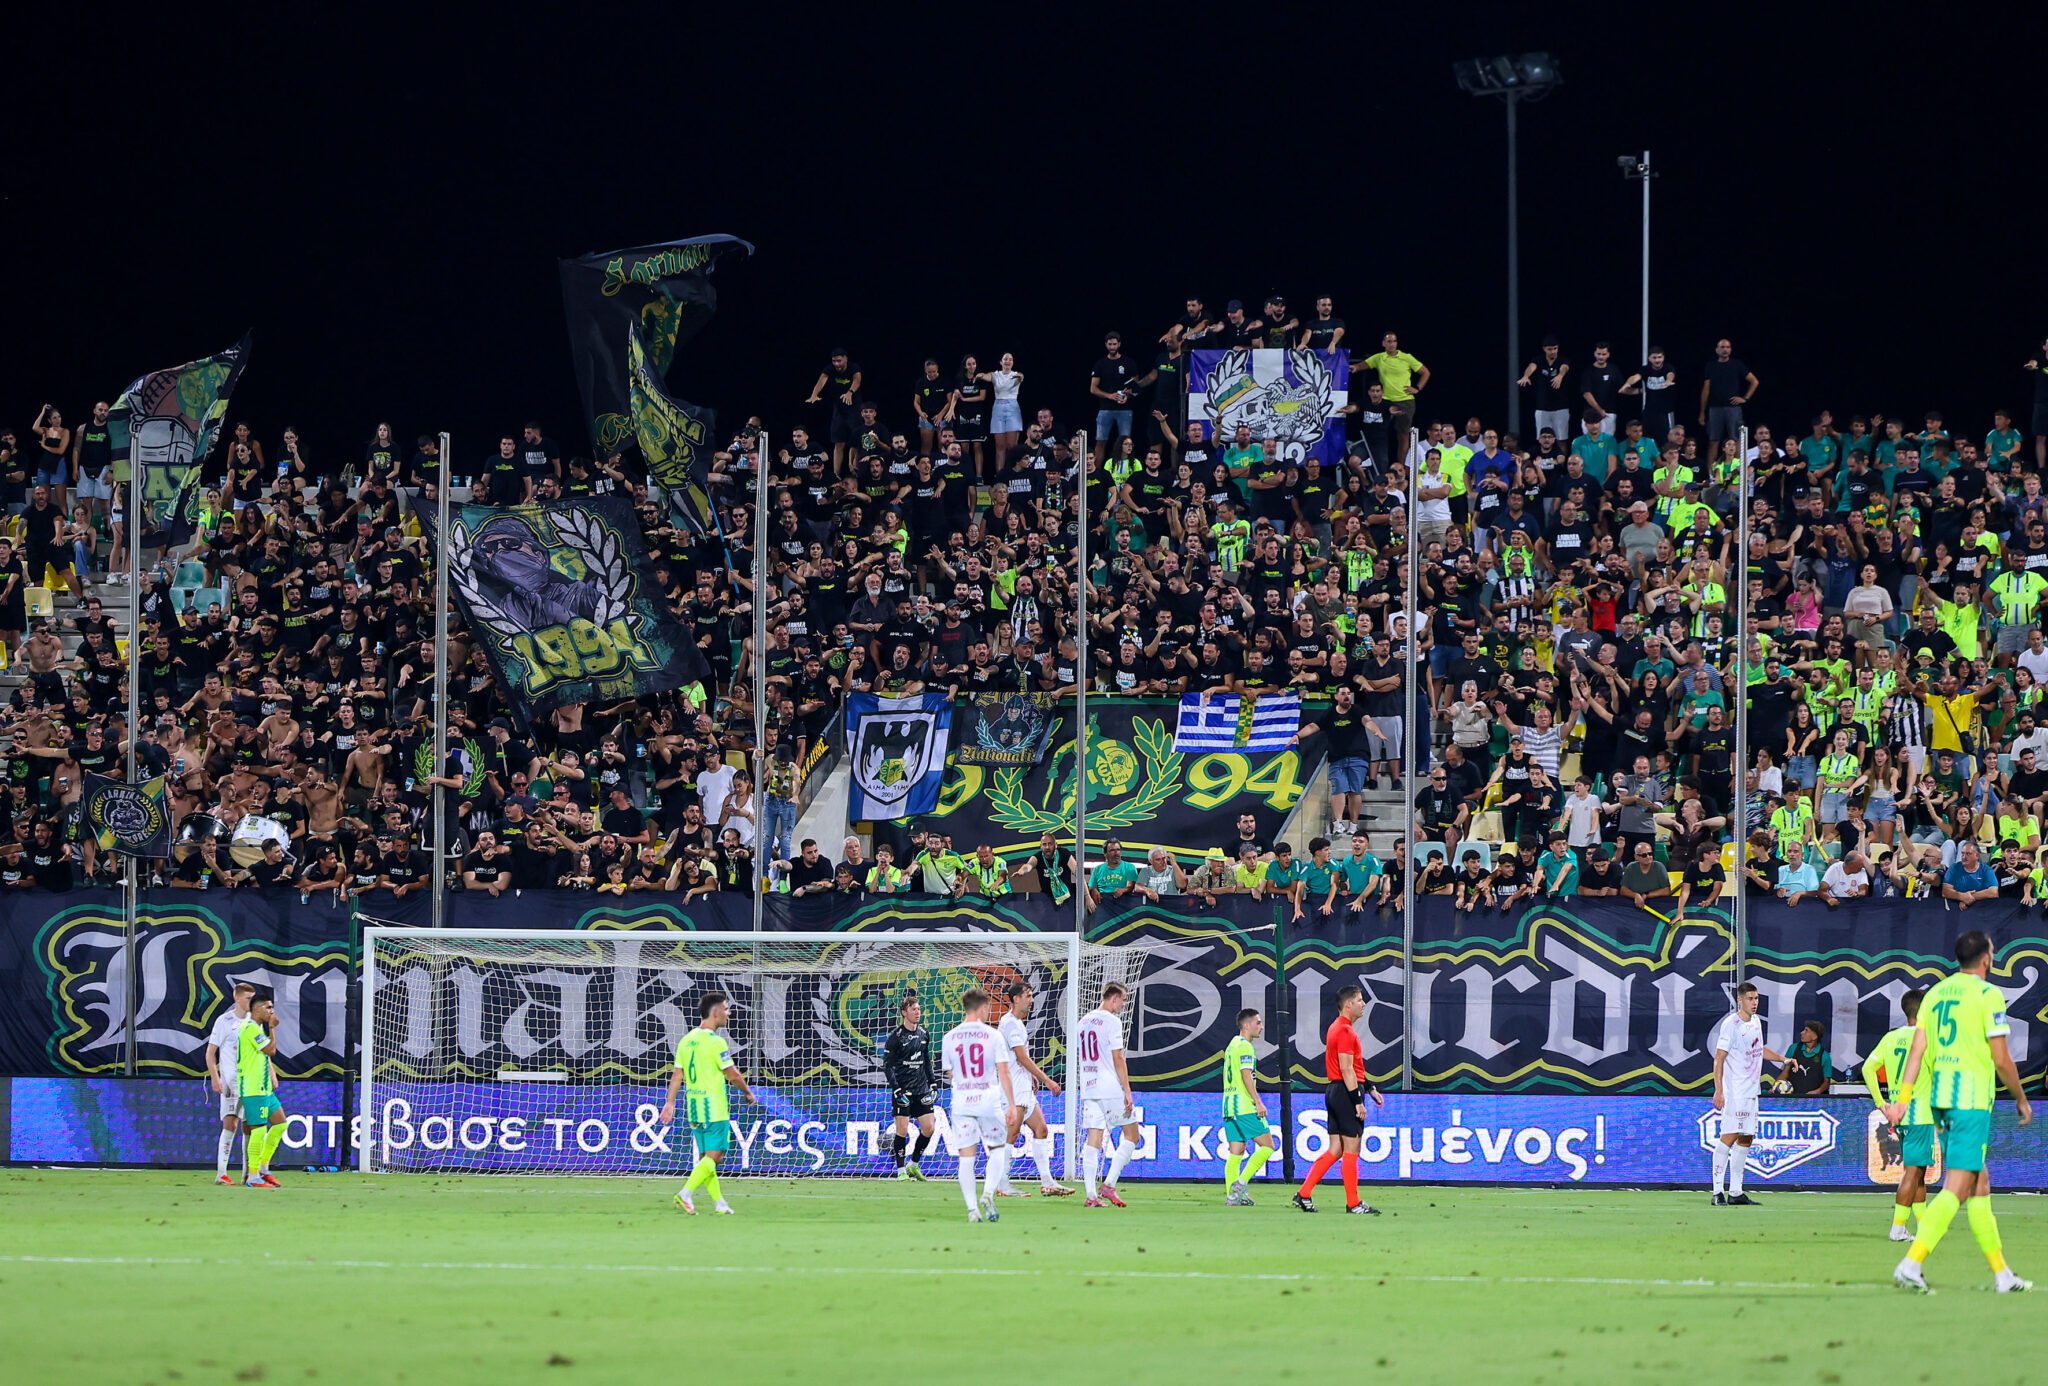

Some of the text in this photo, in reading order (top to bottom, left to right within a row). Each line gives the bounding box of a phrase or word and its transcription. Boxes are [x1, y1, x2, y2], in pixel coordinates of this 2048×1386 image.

[511, 616, 650, 691] 1994
[1184, 750, 1308, 815] 94
[1932, 999, 1960, 1047] 15
[688, 1050, 697, 1084] 6
[955, 1043, 984, 1078] 19
[1080, 1030, 1099, 1062] 10
[1894, 1047, 1907, 1085] 7
[544, 1118, 611, 1153] το
[629, 1103, 673, 1153] &
